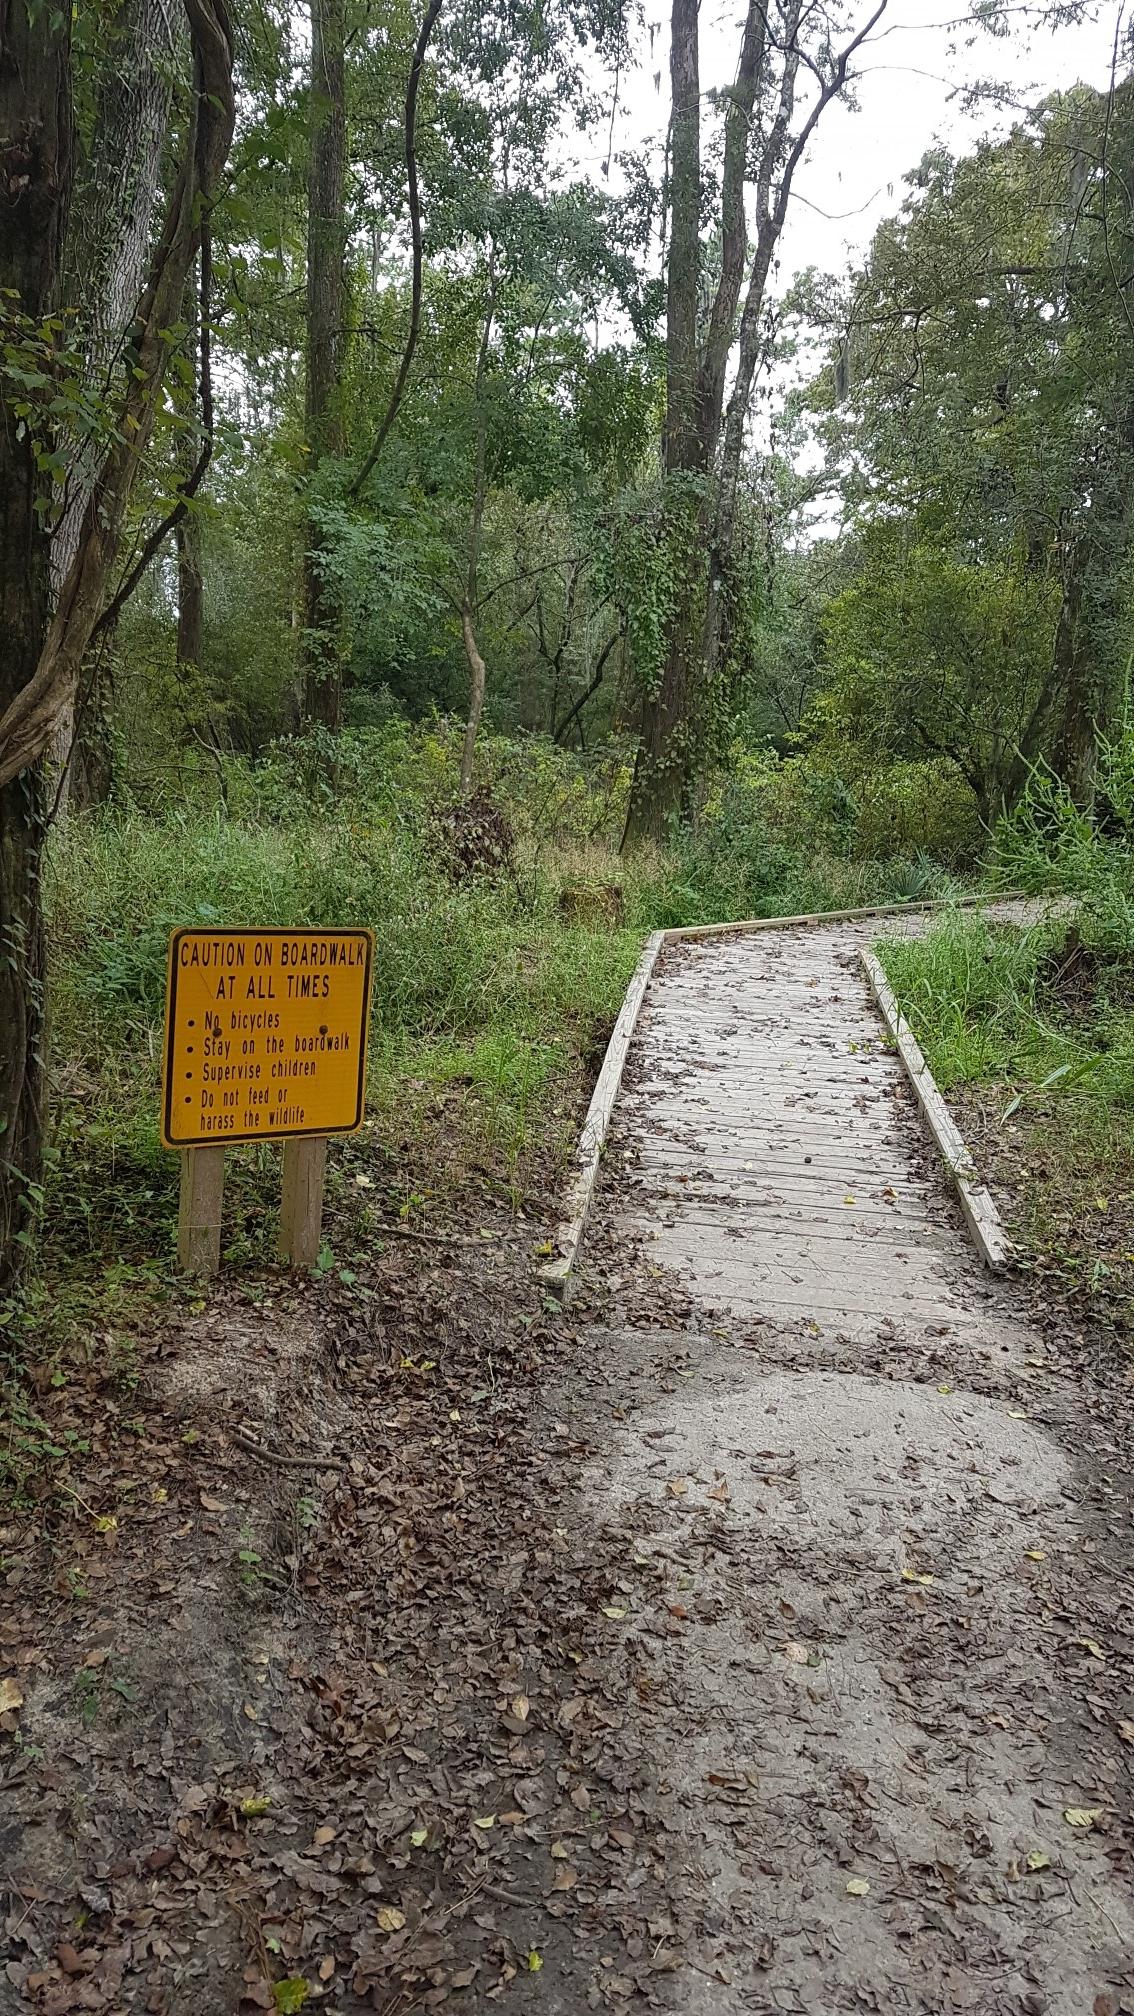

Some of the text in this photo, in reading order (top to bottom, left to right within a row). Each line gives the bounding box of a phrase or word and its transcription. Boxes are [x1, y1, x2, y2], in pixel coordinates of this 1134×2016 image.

[181, 942, 363, 967] CAUTION ON BOARDWALK
[216, 975, 329, 999] AT ALL TIMES
[205, 1010, 280, 1033] No bicycles
[204, 1032, 349, 1060] Stay on the boardwalk
[203, 1060, 316, 1084] Supervise children
[201, 1087, 288, 1108] Do not feed or
[201, 1106, 304, 1131] harass the wildlife
